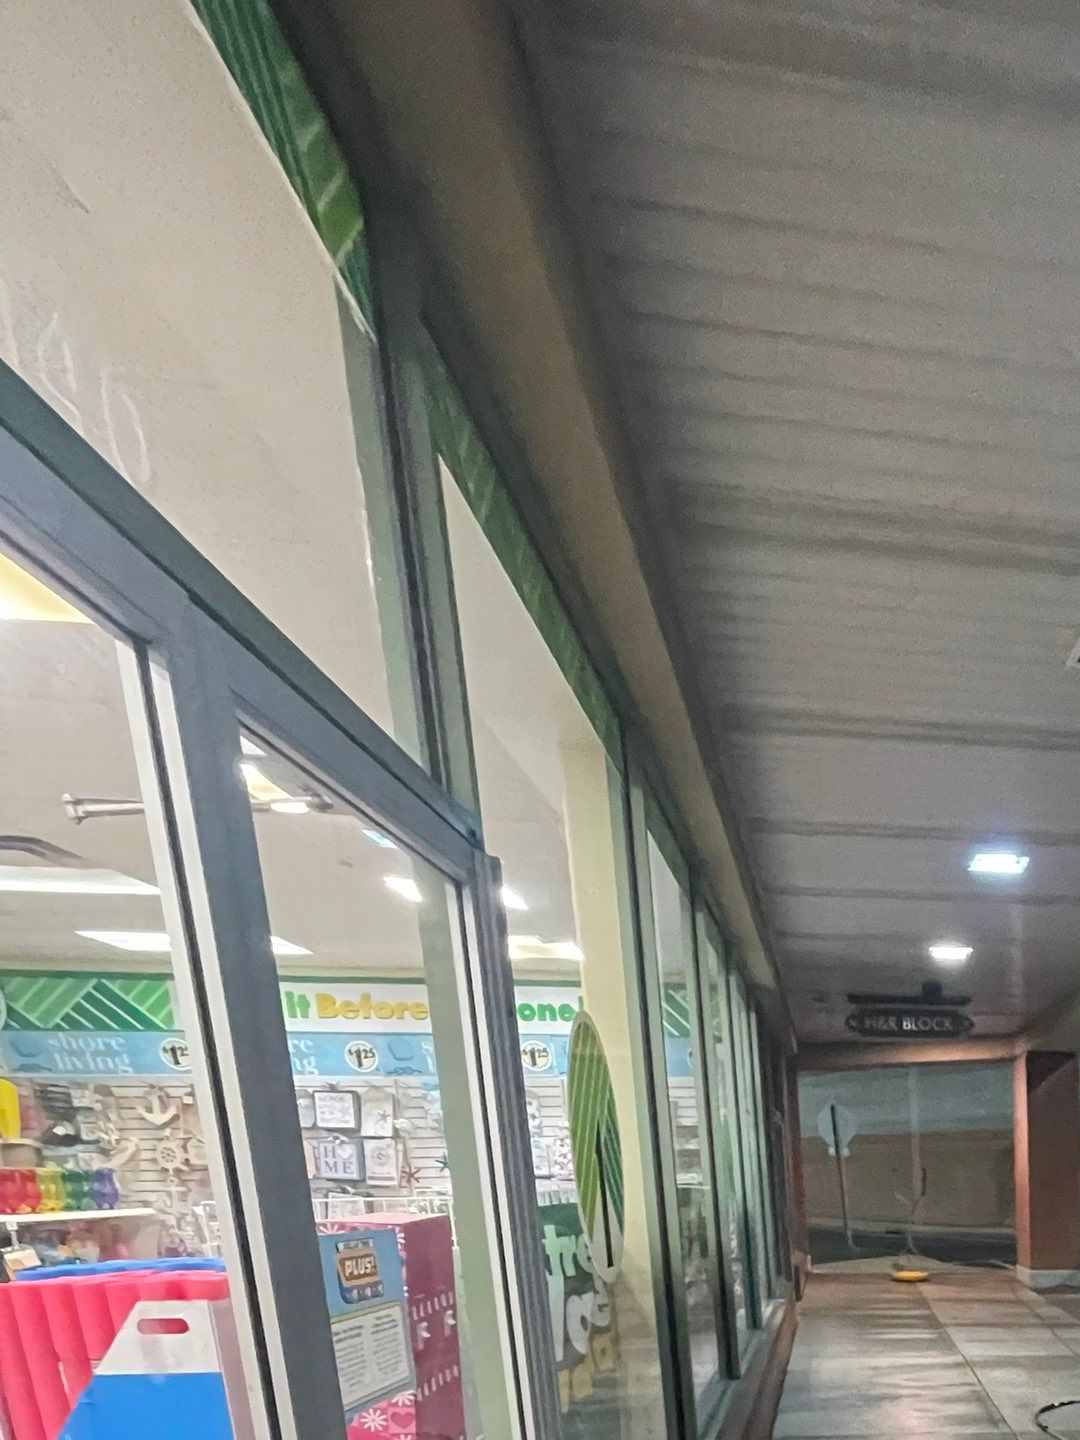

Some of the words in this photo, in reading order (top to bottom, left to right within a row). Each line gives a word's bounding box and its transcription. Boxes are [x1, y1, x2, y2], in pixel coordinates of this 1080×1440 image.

[285, 991, 311, 1019] It
[315, 992, 429, 1020] Before
[902, 1015, 953, 1031] BLOCK
[48, 1031, 127, 1051] shore
[54, 1051, 134, 1074] living
